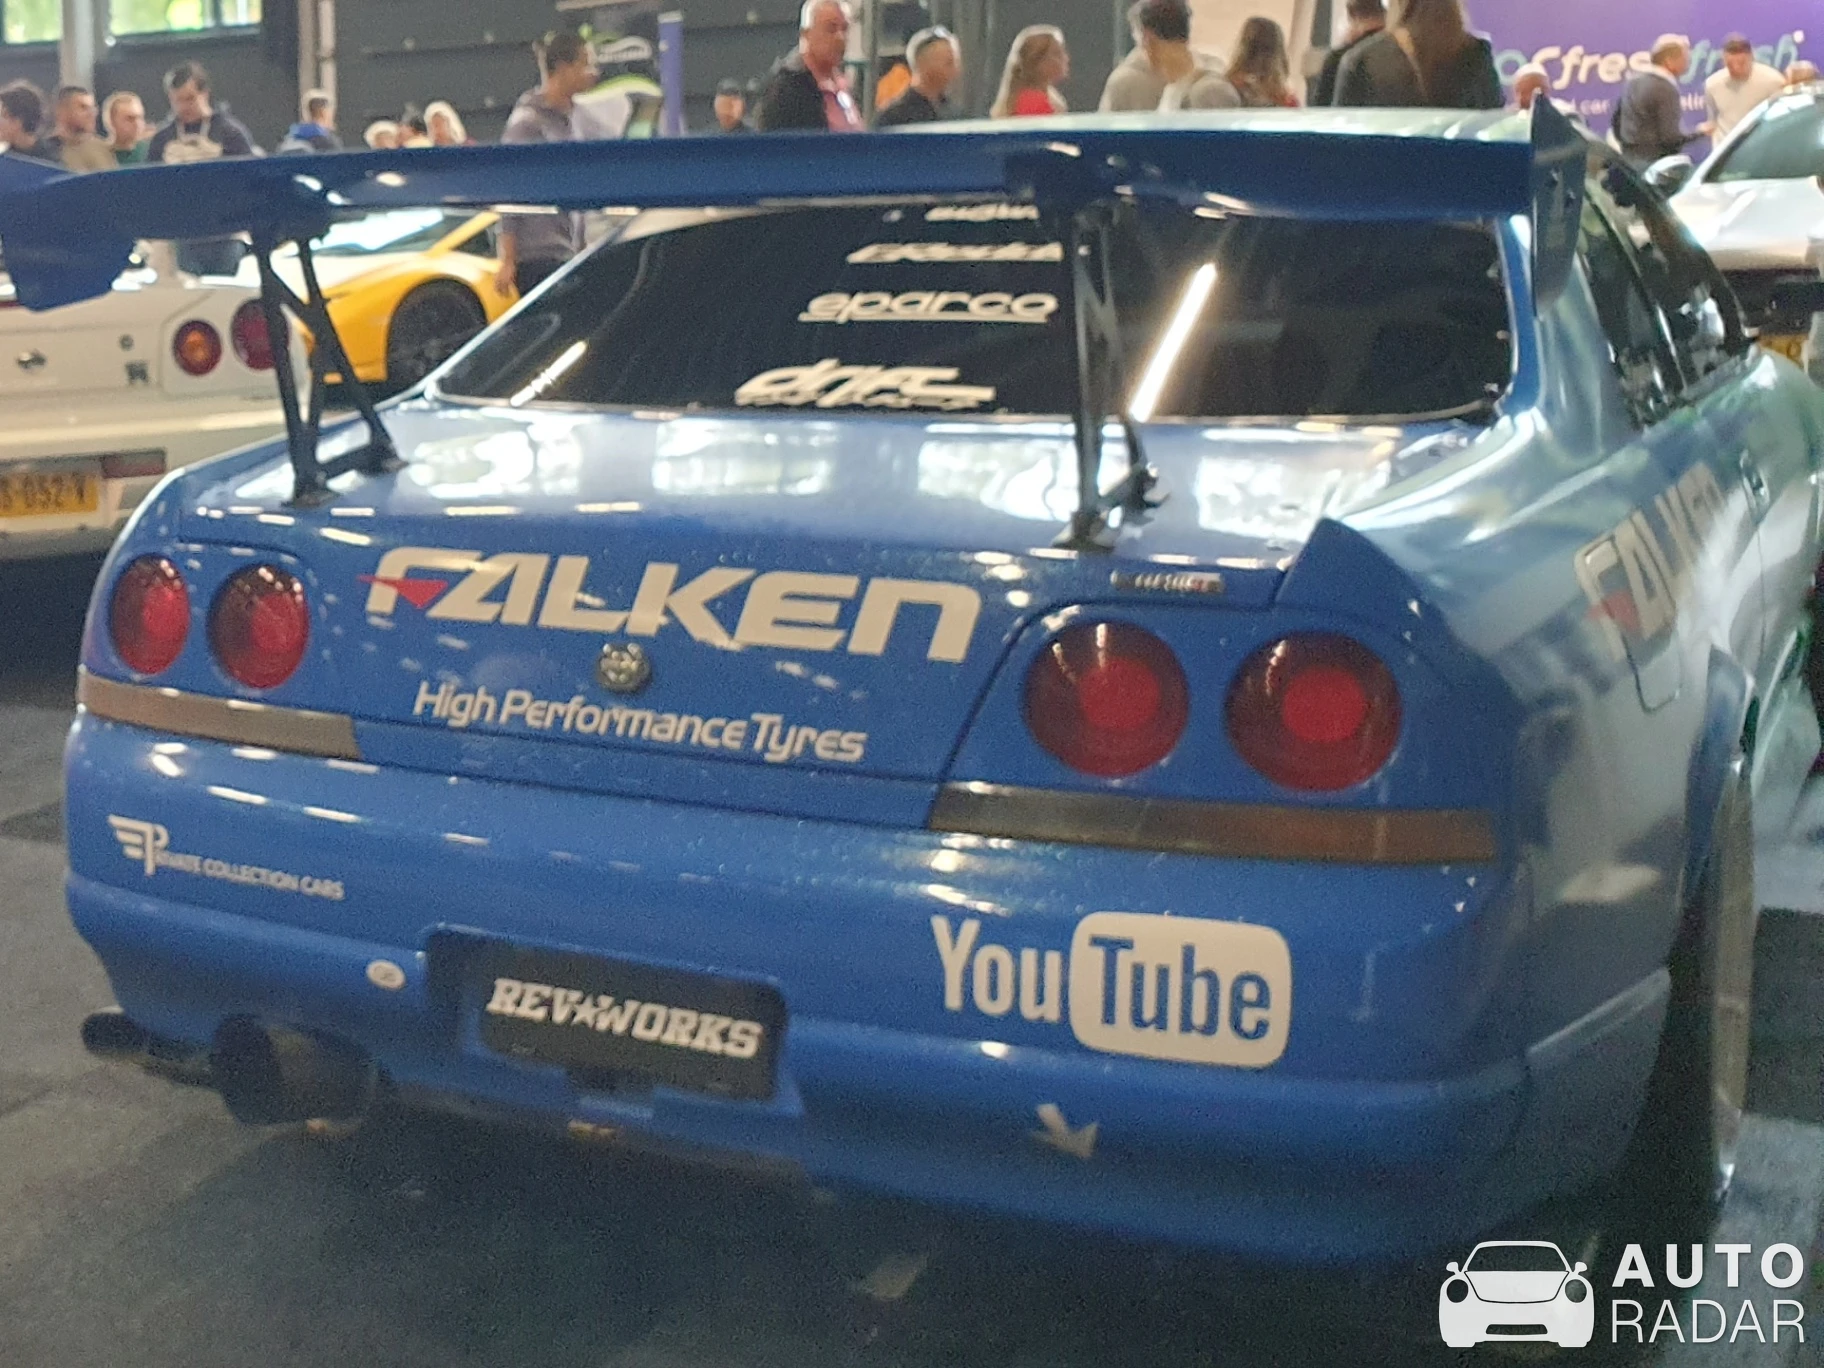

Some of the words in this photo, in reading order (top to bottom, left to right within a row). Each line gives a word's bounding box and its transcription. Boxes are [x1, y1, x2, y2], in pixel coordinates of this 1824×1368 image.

[360, 546, 982, 663] FALKEN
[412, 680, 497, 728] High
[499, 688, 748, 749] Performance
[749, 713, 869, 763] Tyres
[930, 913, 1273, 1042] YouTube
